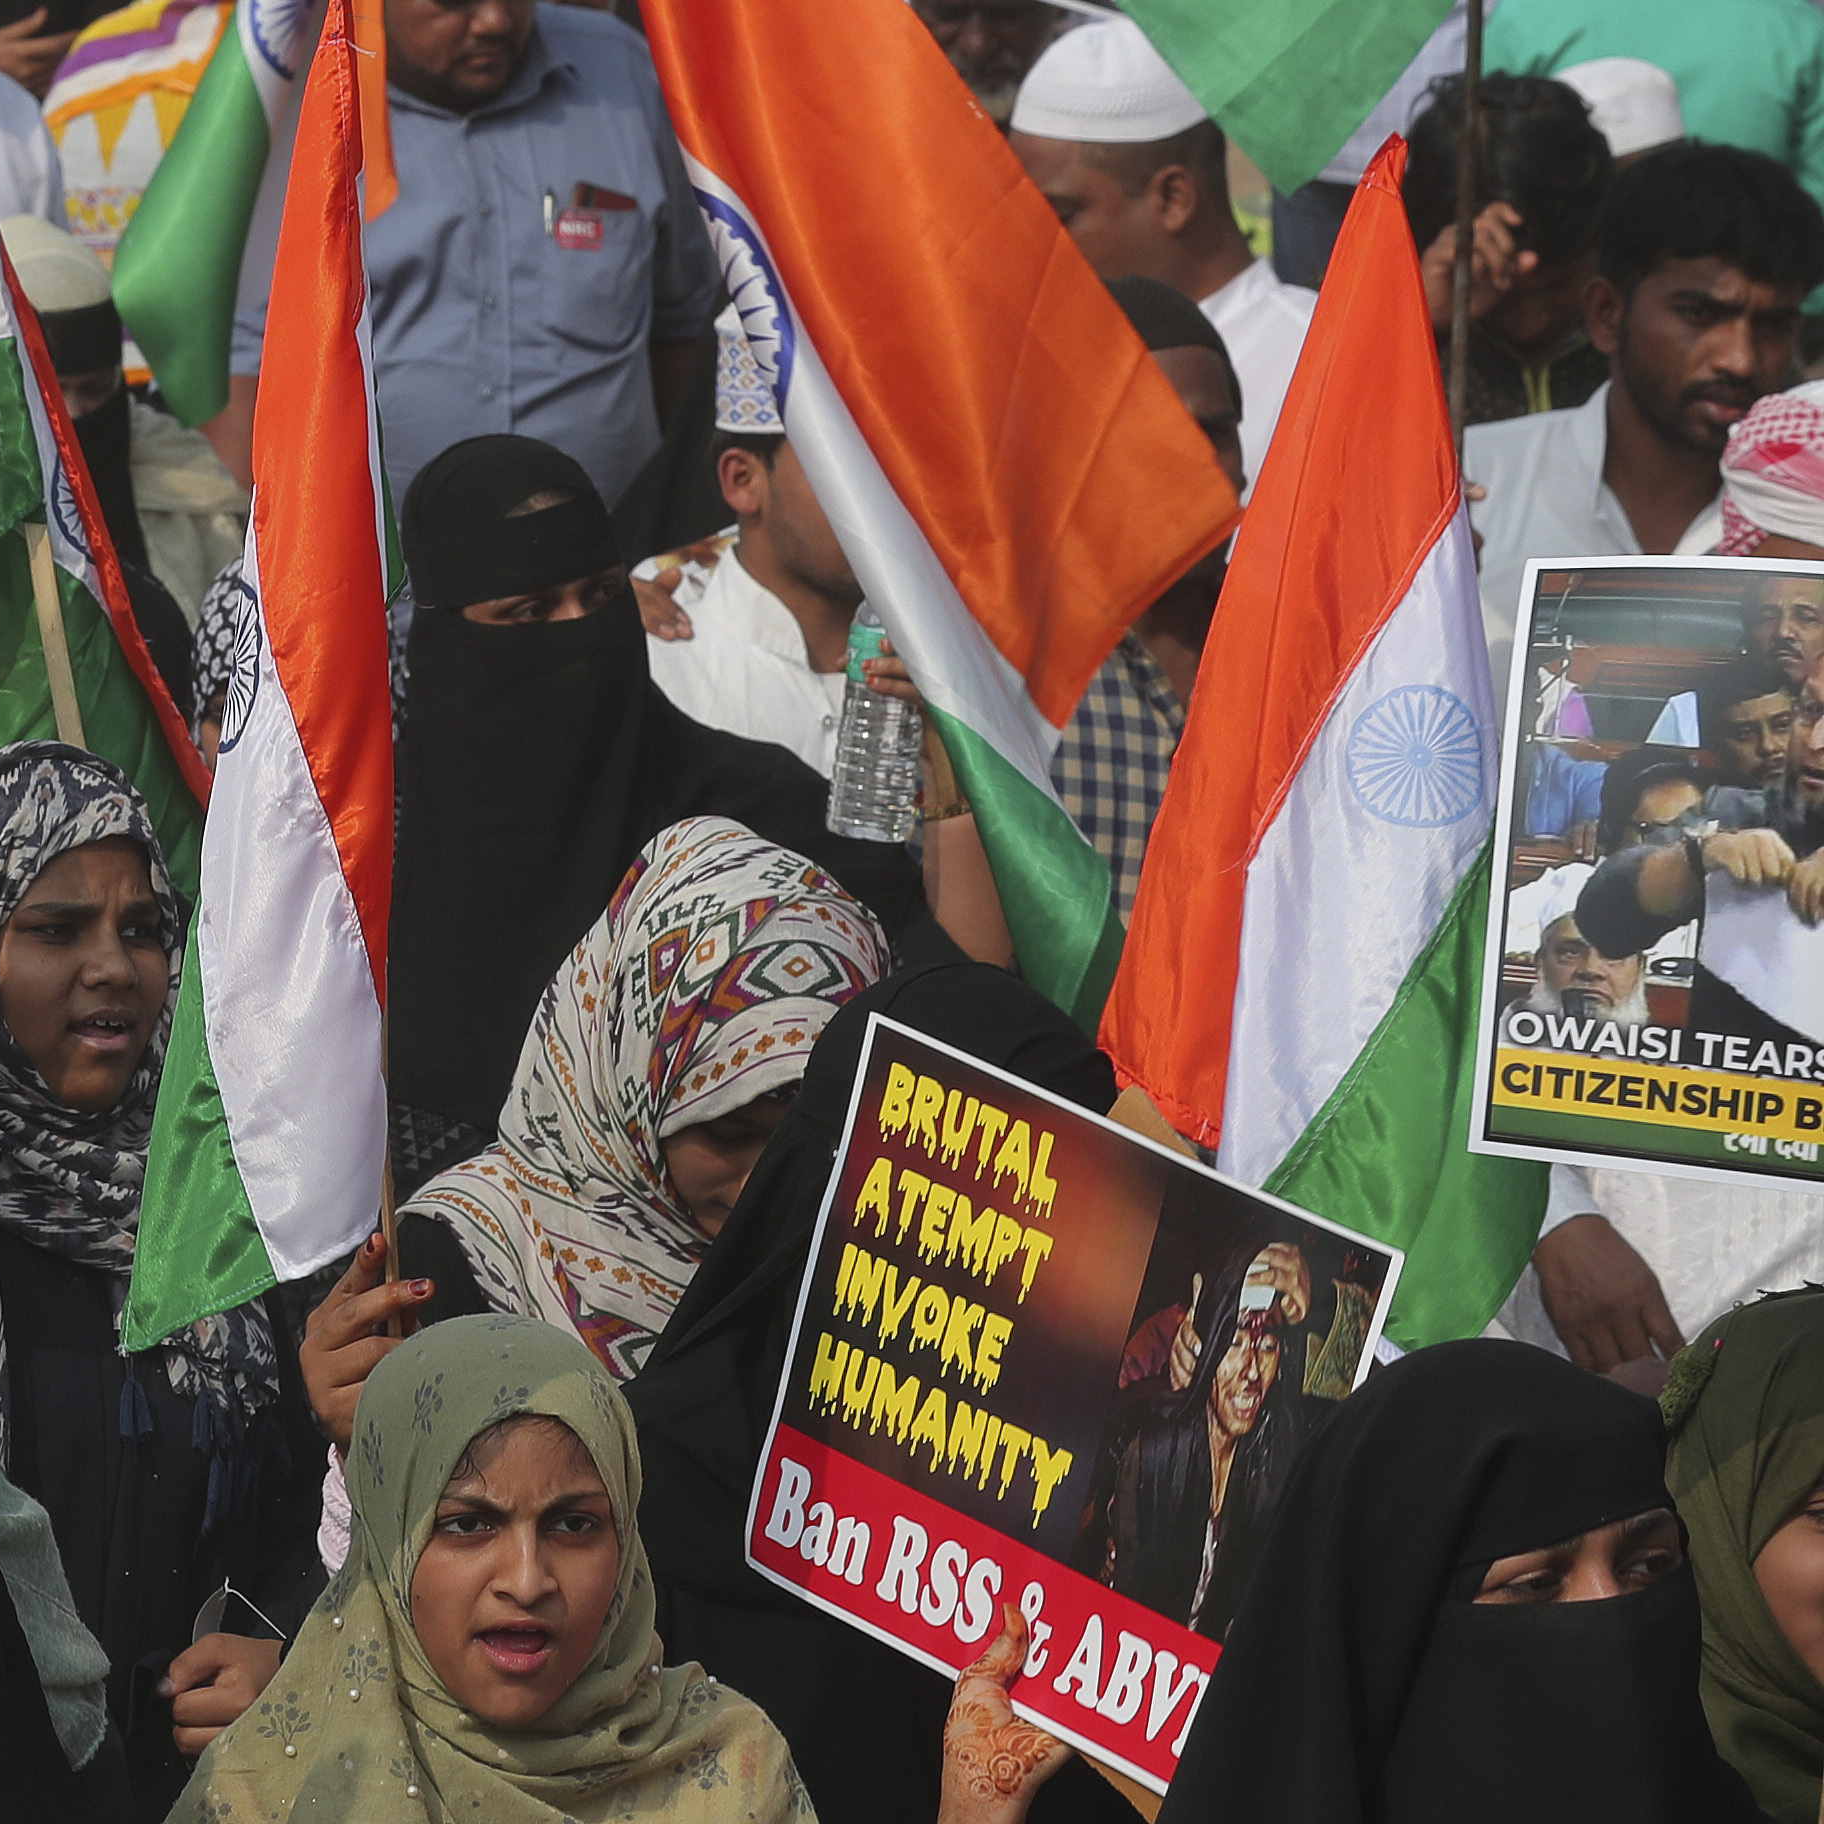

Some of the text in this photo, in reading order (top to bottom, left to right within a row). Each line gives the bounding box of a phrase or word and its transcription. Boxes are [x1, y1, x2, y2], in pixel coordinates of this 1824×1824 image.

[1501, 1062, 1824, 1131] CITIZENSHIP B
[1508, 1009, 1824, 1080] OWAISI TEARS
[879, 1062, 1057, 1218] BRUTAL
[833, 1242, 1014, 1397] INVOKE
[808, 1331, 1073, 1530] HUMANITY
[765, 1457, 871, 1585] Ban
[876, 1515, 1002, 1643] RSS
[1019, 1581, 1053, 1678] &
